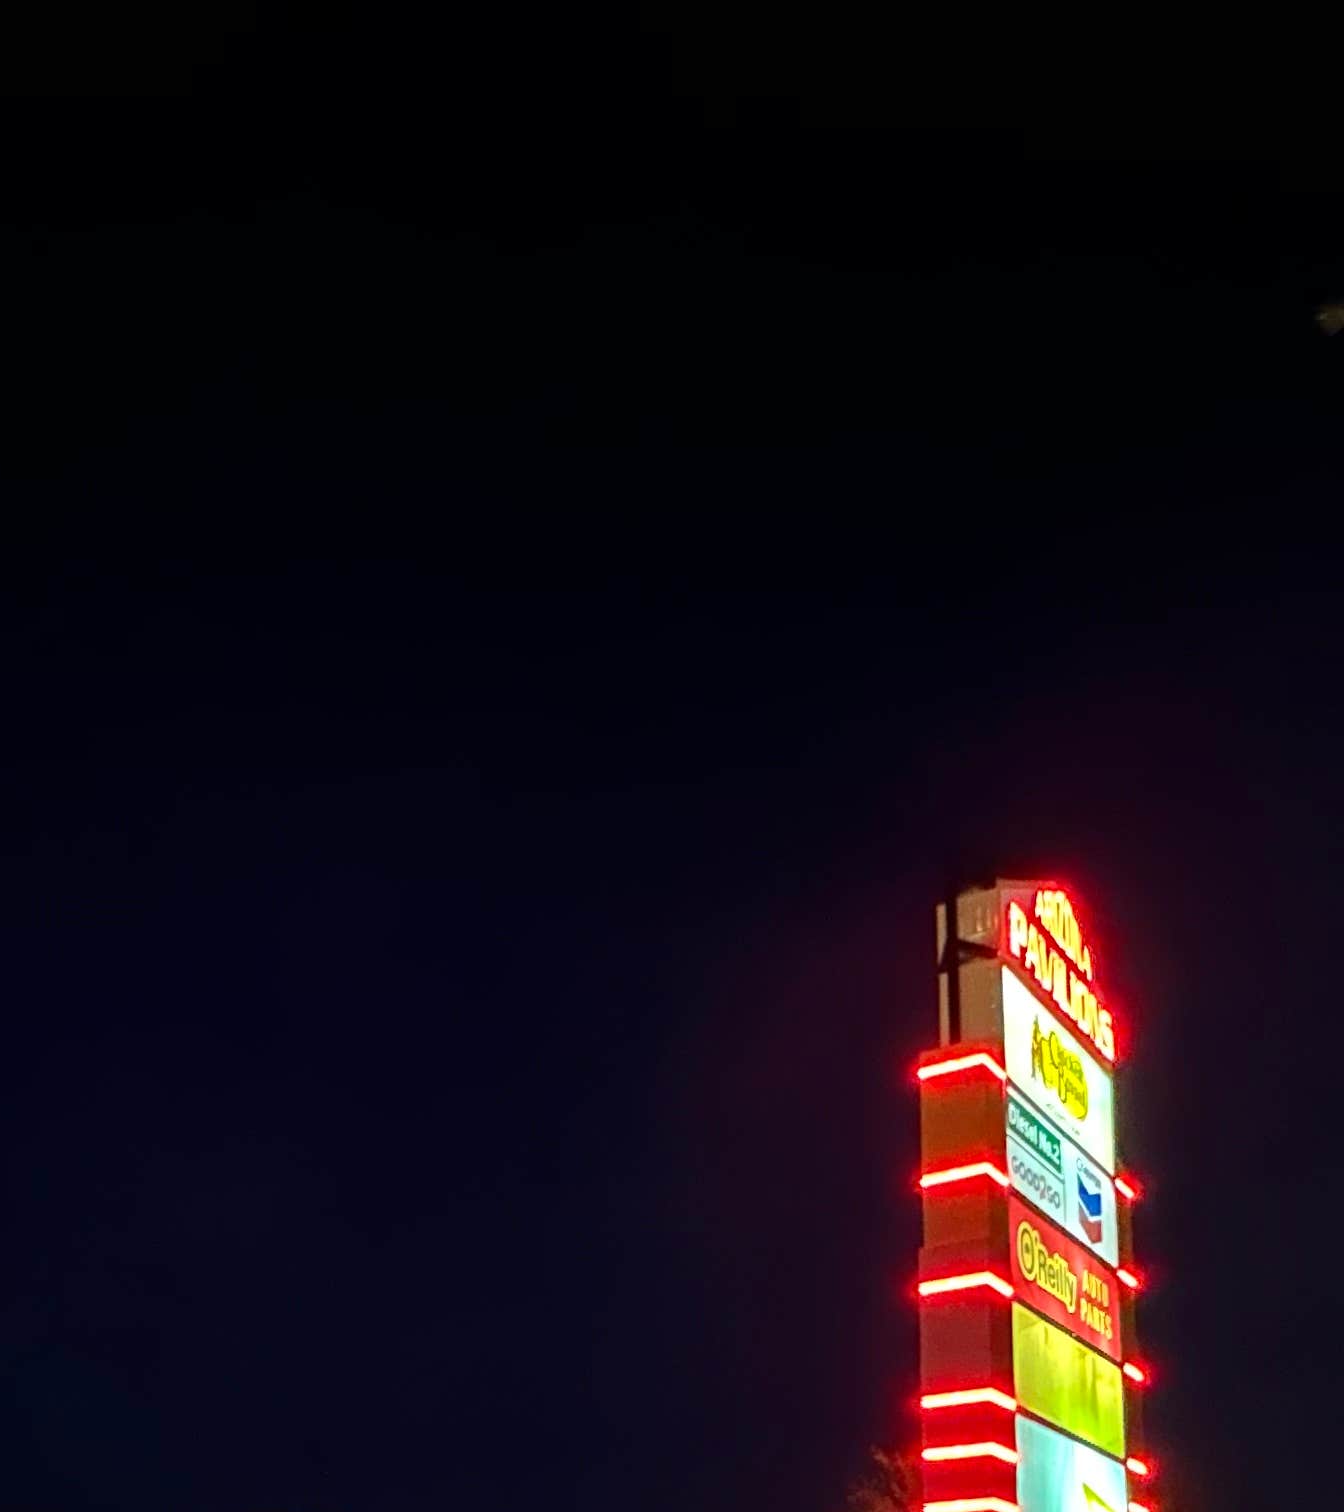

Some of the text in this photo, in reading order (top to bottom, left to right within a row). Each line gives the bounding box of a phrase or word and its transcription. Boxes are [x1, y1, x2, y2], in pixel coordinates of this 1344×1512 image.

[1009, 901, 1116, 1062] PAVILIONS
[1019, 1225, 1076, 1310] O'Reilly
[1082, 1269, 1110, 1308] AUTO
[1080, 1297, 1114, 1340] PARTS
